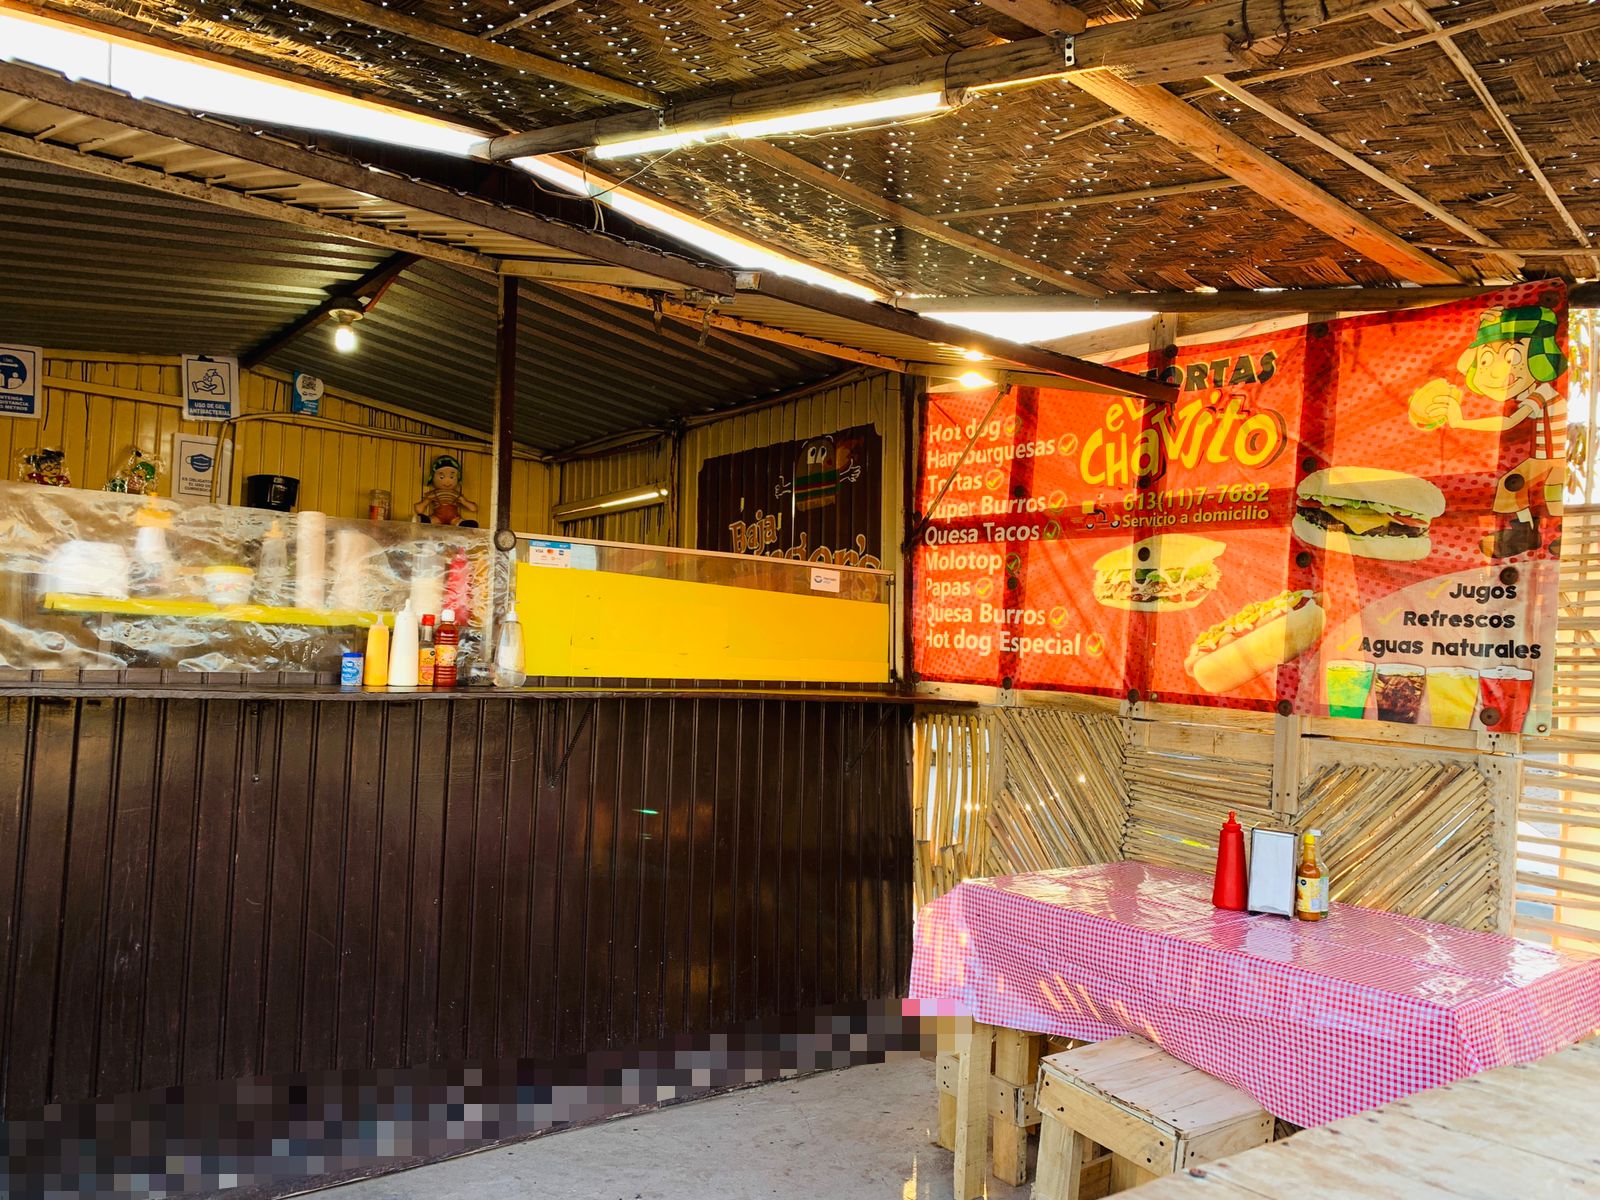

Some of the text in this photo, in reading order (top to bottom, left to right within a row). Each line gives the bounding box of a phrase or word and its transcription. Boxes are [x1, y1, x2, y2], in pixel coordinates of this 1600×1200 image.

[929, 418, 1001, 444] Hot dog
[928, 438, 1056, 470] Hamburguesas
[928, 472, 982, 494] Tortas
[981, 495, 1046, 516] Burros
[1123, 482, 1270, 512] 613(11)7-7682
[1122, 506, 1270, 528] Servicio a domicilio
[728, 509, 778, 555] Baja
[925, 522, 1040, 550] Quesa Tacos
[925, 550, 1002, 575] Molotop
[926, 578, 971, 600] Papas
[1449, 583, 1517, 604] Jugos
[927, 603, 1046, 627] Quesa Burros
[1403, 610, 1516, 628] Refrescos
[926, 628, 1081, 658] Hot dog Especial
[1358, 636, 1542, 660] Aguas naturales
